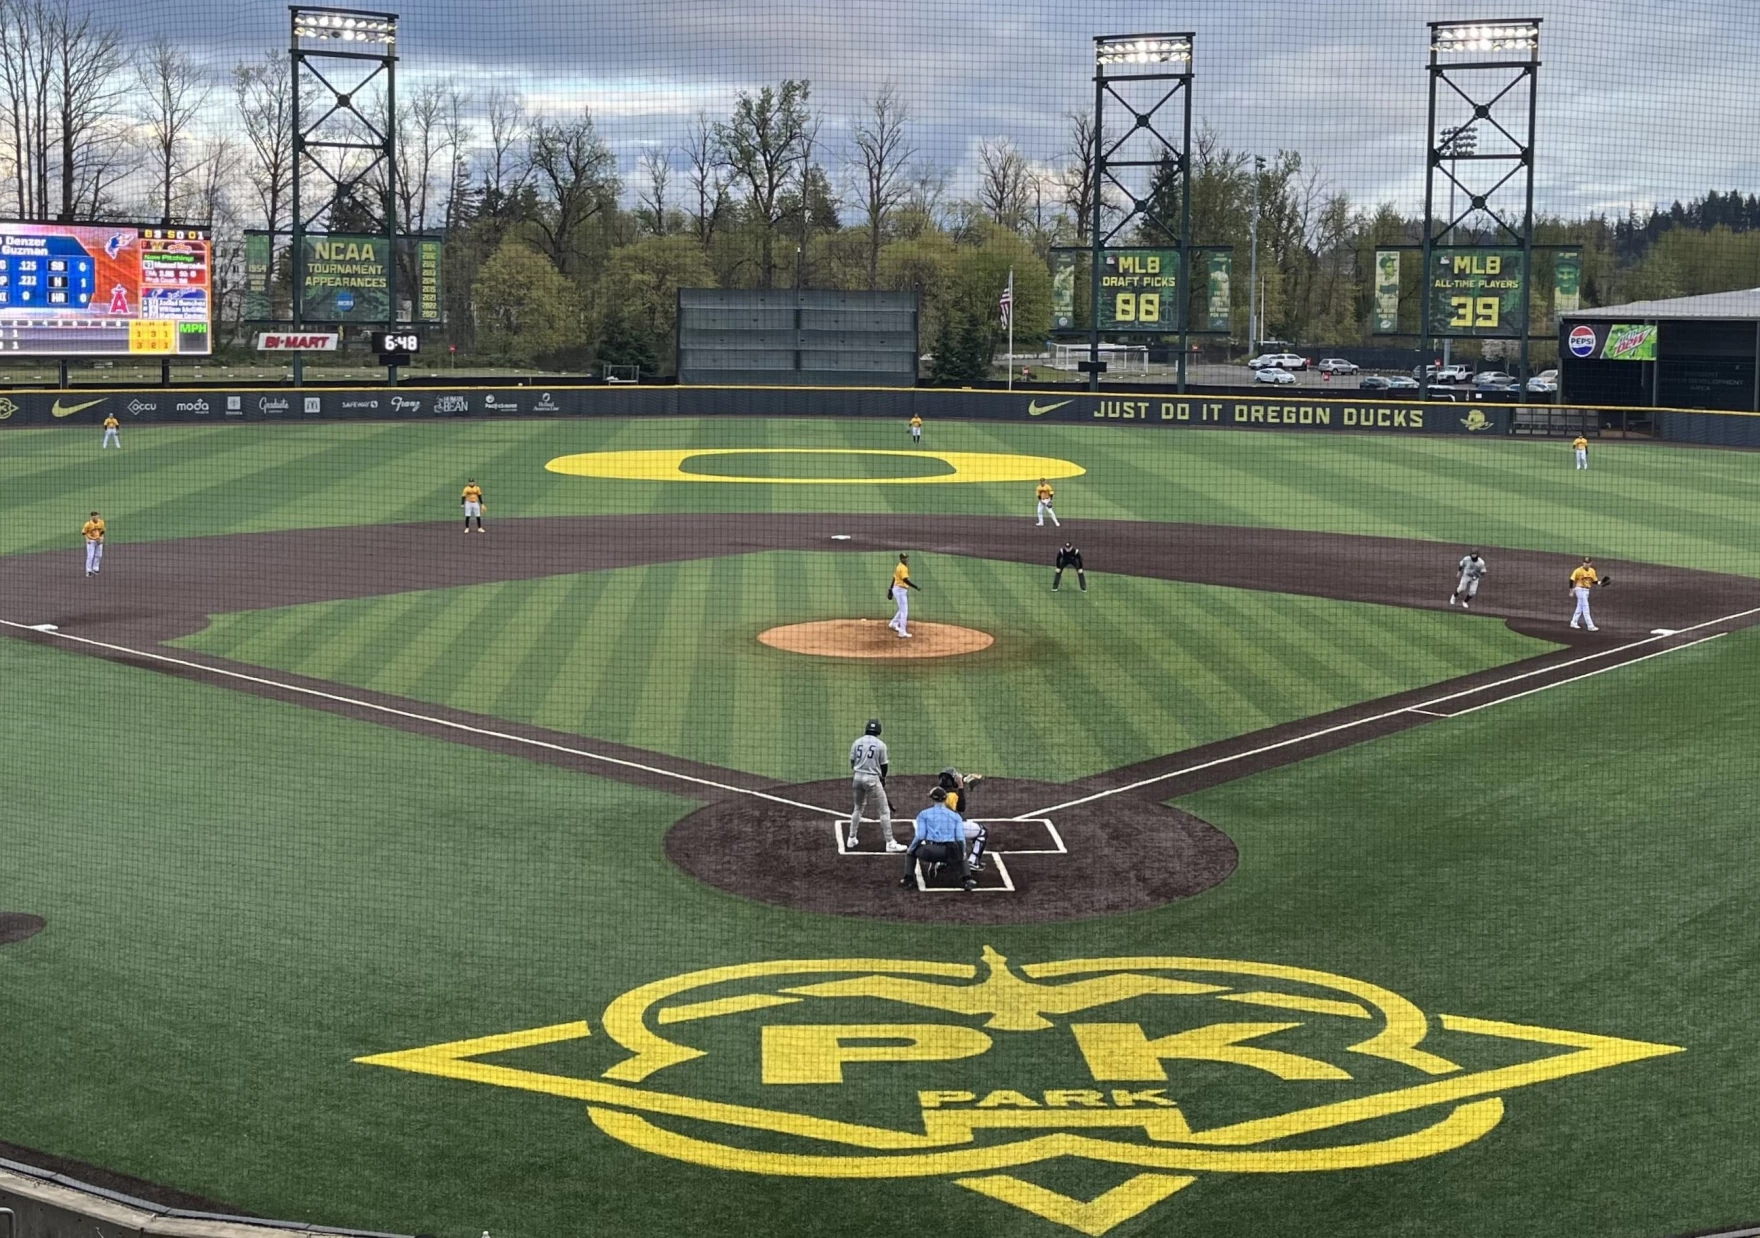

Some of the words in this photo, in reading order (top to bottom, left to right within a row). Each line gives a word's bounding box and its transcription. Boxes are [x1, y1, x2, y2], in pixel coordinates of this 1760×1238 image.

[6, 236, 46, 247] Denzer
[2, 245, 48, 256] Guzman
[314, 243, 375, 261] NCAA
[19, 261, 37, 271] .125
[51, 261, 64, 271] SB
[79, 262, 87, 272] 0
[307, 263, 383, 275] TOURNAMENT
[1118, 256, 1160, 274] MLB
[1453, 256, 1501, 274] MLB
[54, 277, 62, 286] H
[81, 278, 86, 288] 1
[305, 276, 387, 288] APPEARANCES
[1102, 276, 1139, 287] DRAFT
[1143, 277, 1175, 287] PICKS
[1434, 279, 1475, 288] ALL-TIME
[1478, 280, 1519, 289] PLAYERS
[22, 291, 30, 300] 0
[51, 292, 65, 302] HR
[80, 293, 87, 302] 0
[422, 302, 437, 310] 2022
[1115, 293, 1160, 322] 88
[1450, 297, 1500, 327] 39
[180, 323, 206, 333] MPH
[385, 335, 418, 351] 6:48
[1570, 337, 1594, 345] PEPSI
[176, 398, 210, 411] moda
[443, 401, 469, 412] BEAN
[1093, 401, 1149, 419] JUST
[1161, 403, 1190, 420] DO
[1202, 404, 1222, 421] IT
[1234, 404, 1330, 424] OREGON
[1343, 407, 1423, 428] DUCKS
[918, 1088, 1177, 1108] PARK
